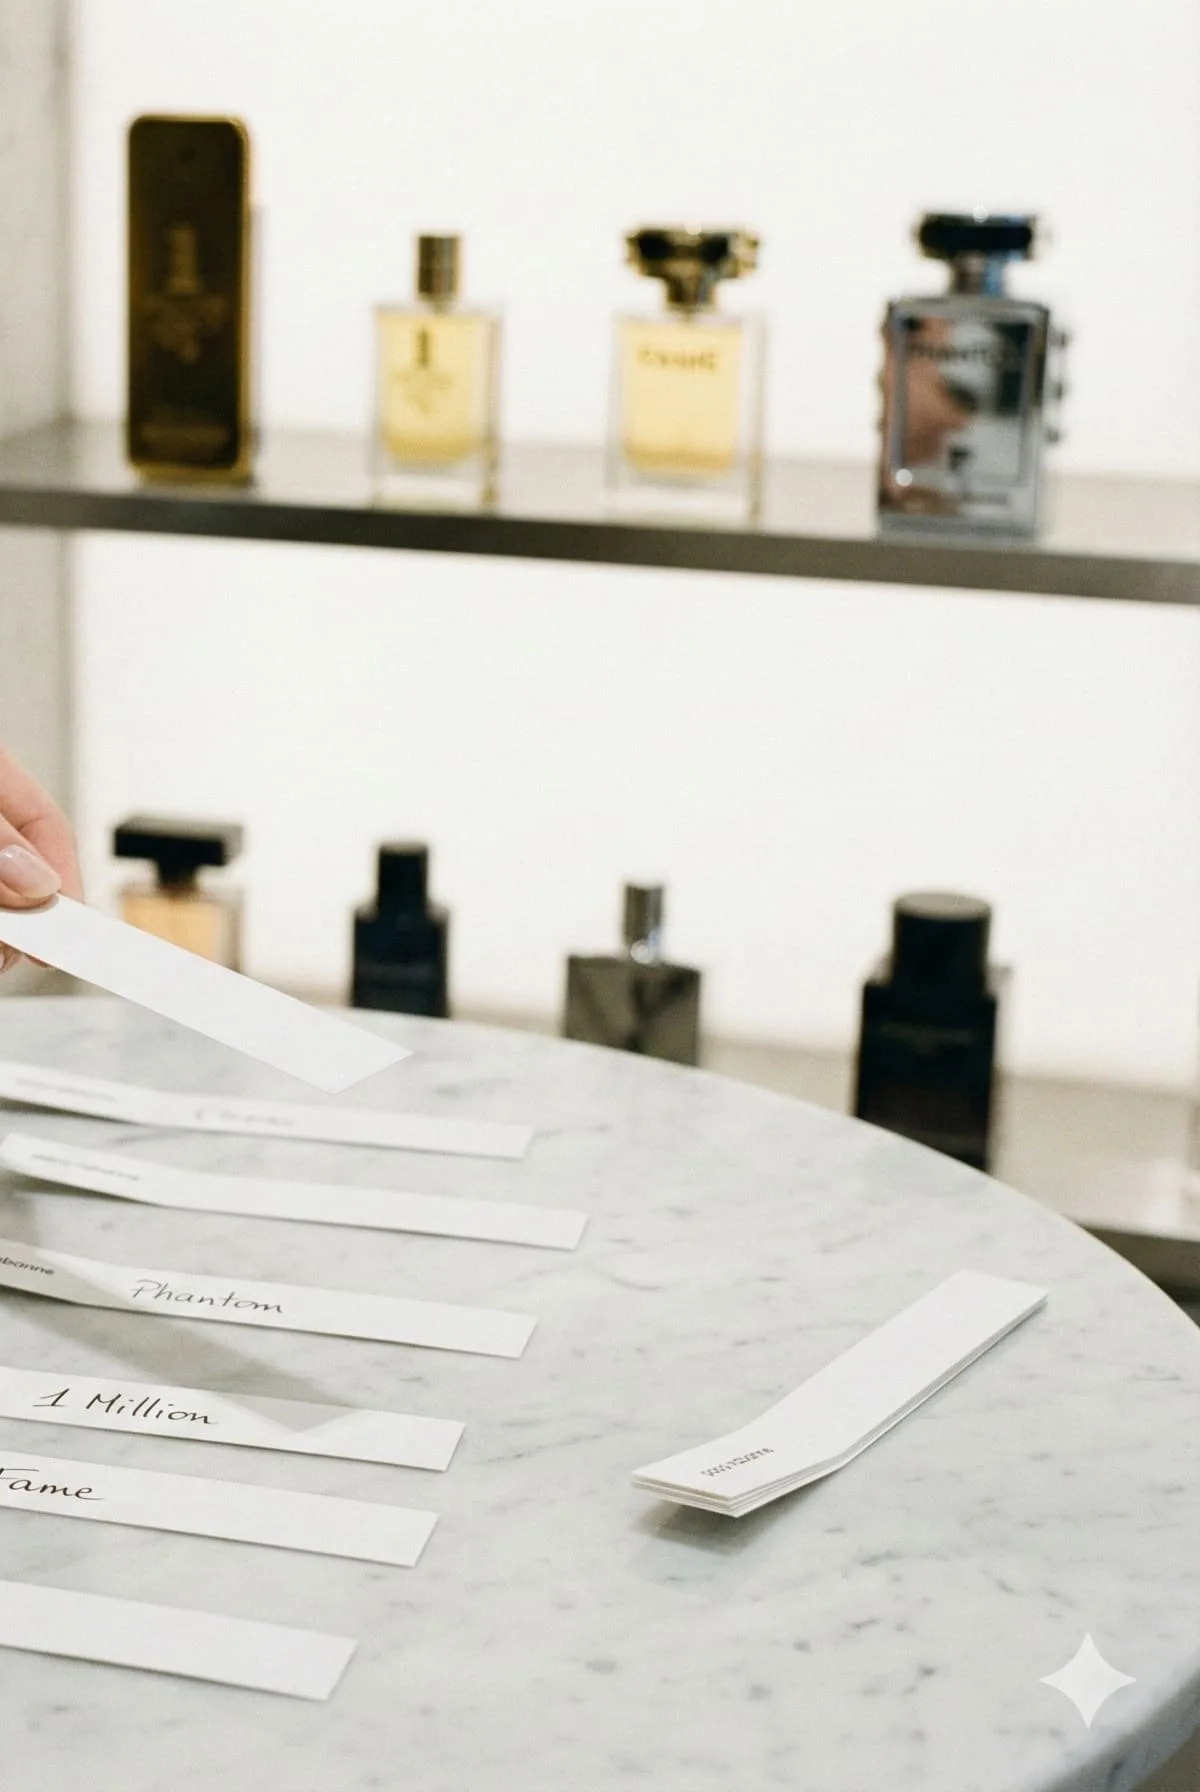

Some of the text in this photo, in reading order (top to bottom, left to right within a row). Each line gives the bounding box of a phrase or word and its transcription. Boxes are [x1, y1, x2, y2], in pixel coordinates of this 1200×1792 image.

[130, 1279, 284, 1314] Phantom
[32, 1388, 219, 1425] 1 Million
